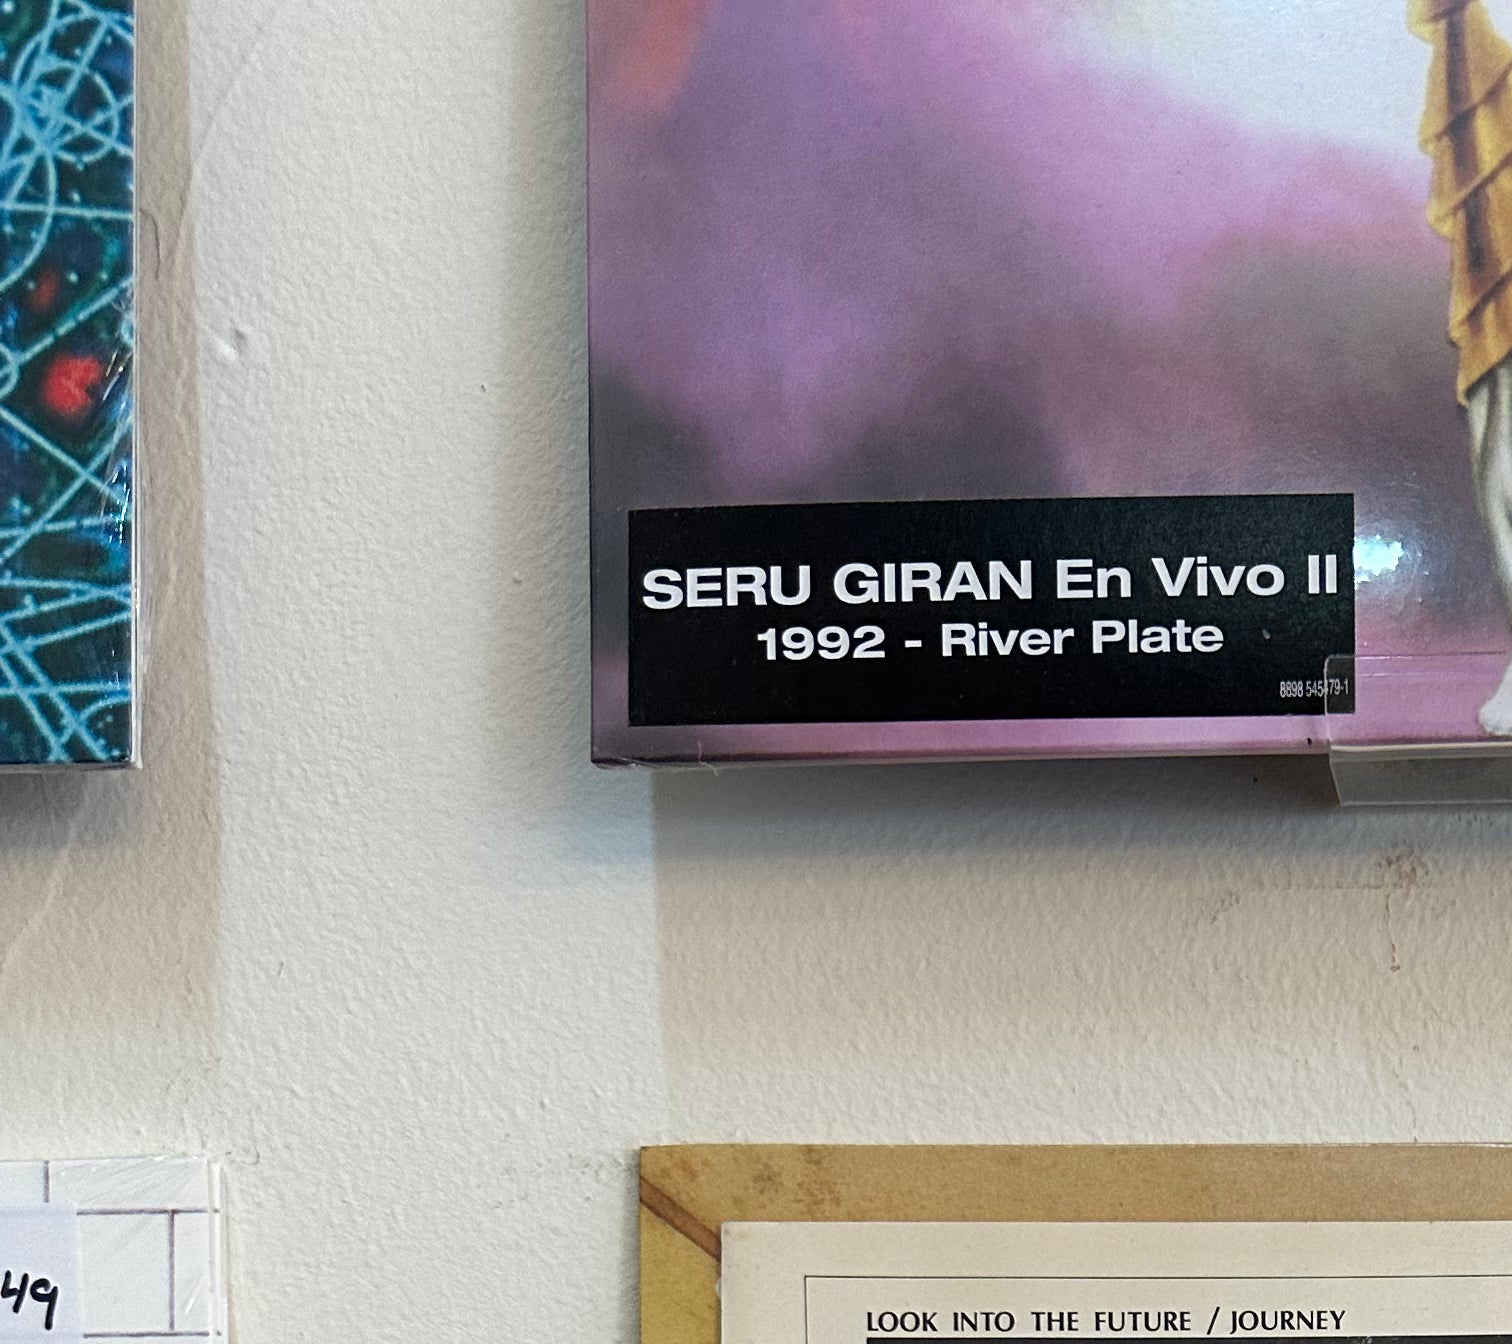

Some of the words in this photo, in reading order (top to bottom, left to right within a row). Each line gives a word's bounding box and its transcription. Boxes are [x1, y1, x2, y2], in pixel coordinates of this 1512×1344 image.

[643, 565, 810, 609] SERU
[834, 560, 1032, 604] GIRAN
[1057, 559, 1131, 598] En
[1151, 556, 1284, 596] Vivo
[1308, 554, 1337, 594] II
[757, 626, 885, 660] 1992
[942, 622, 1074, 656] River
[1092, 619, 1223, 653] Plate
[867, 1312, 937, 1332] LOOK
[953, 1311, 1015, 1332] INTO
[1031, 1312, 1078, 1331] THE
[1095, 1312, 1191, 1332] FUTURE
[1230, 1310, 1345, 1334] JOURNEY
